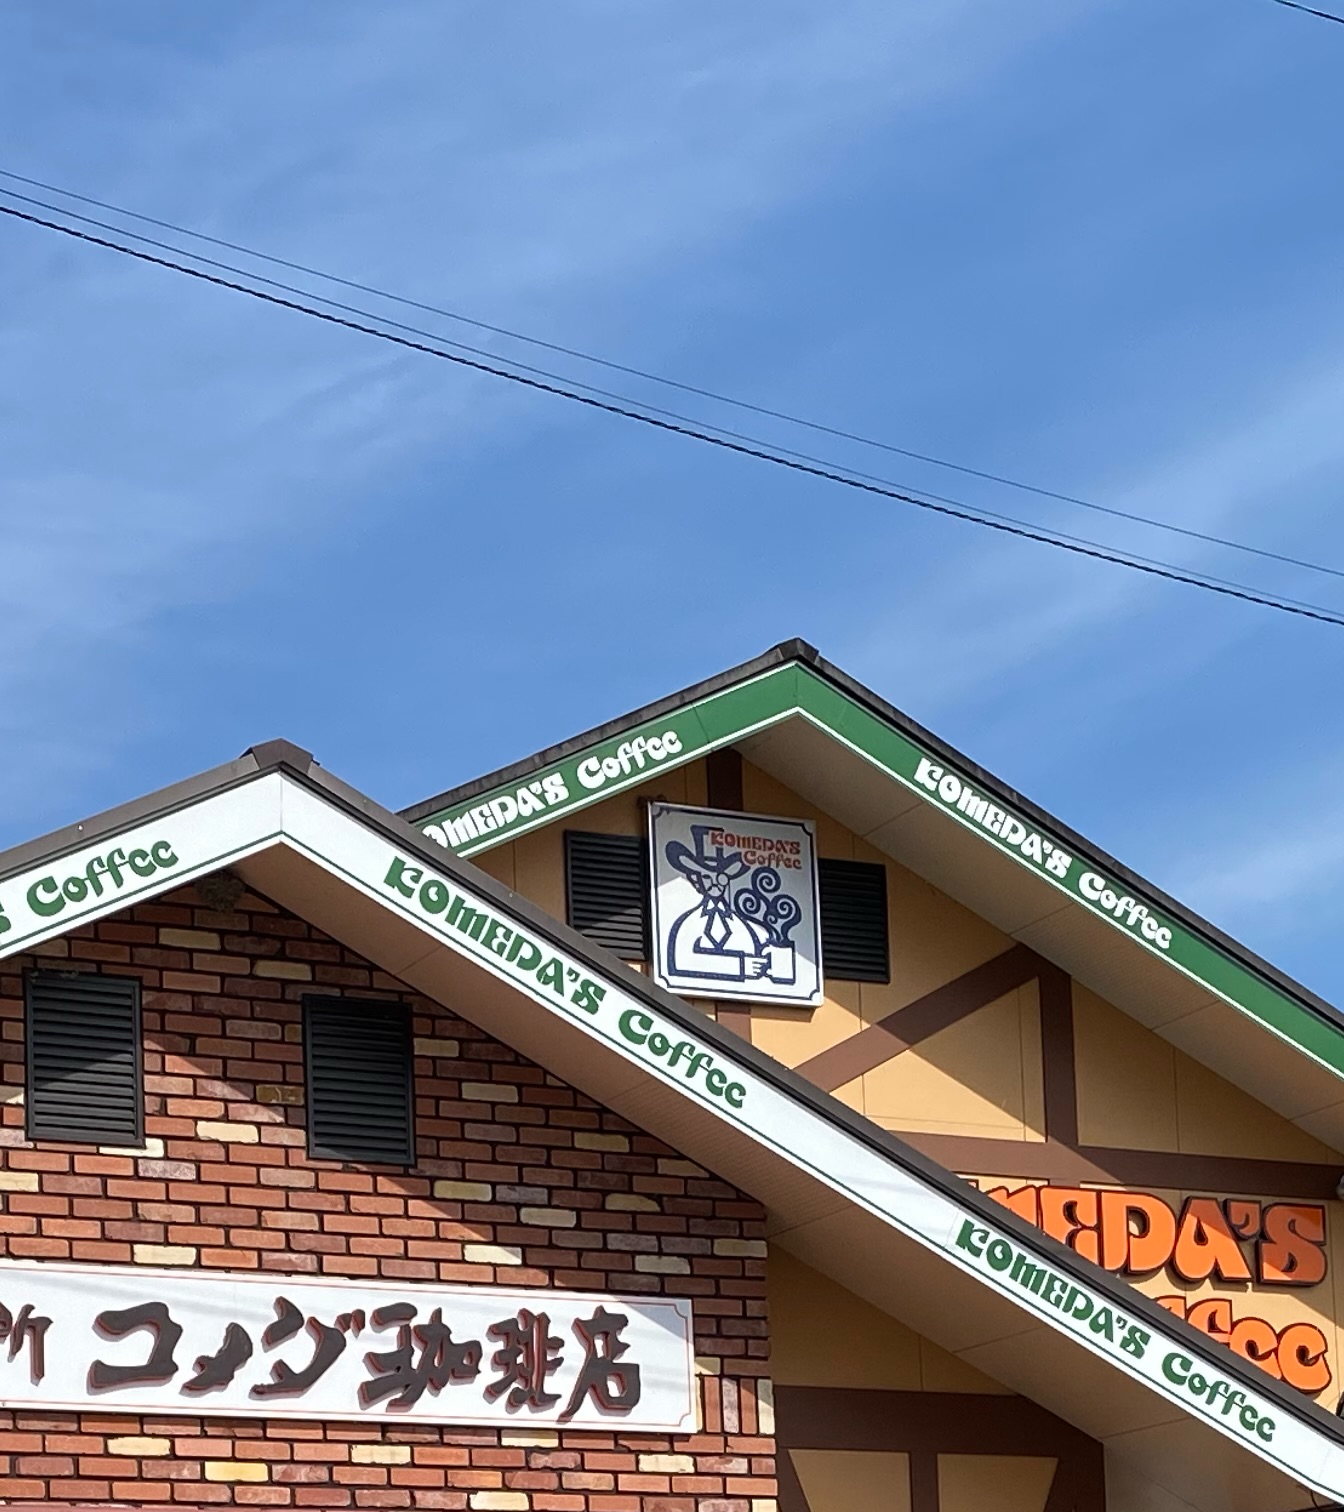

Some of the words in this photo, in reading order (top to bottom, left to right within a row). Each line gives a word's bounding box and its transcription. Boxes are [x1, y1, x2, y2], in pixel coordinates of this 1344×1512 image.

[576, 731, 684, 790] Coffee
[26, 840, 179, 917] Coffee
[710, 829, 802, 855] KOMEDA'S
[741, 850, 803, 870] Coffee
[913, 757, 1073, 879] KOMEDA'S
[1079, 871, 1173, 949] Coffee
[383, 856, 606, 1015] KOMEDA'S
[618, 1009, 747, 1109] Coffee
[956, 1218, 1151, 1359] KOMEDA'S
[1161, 1352, 1276, 1442] Coffee
